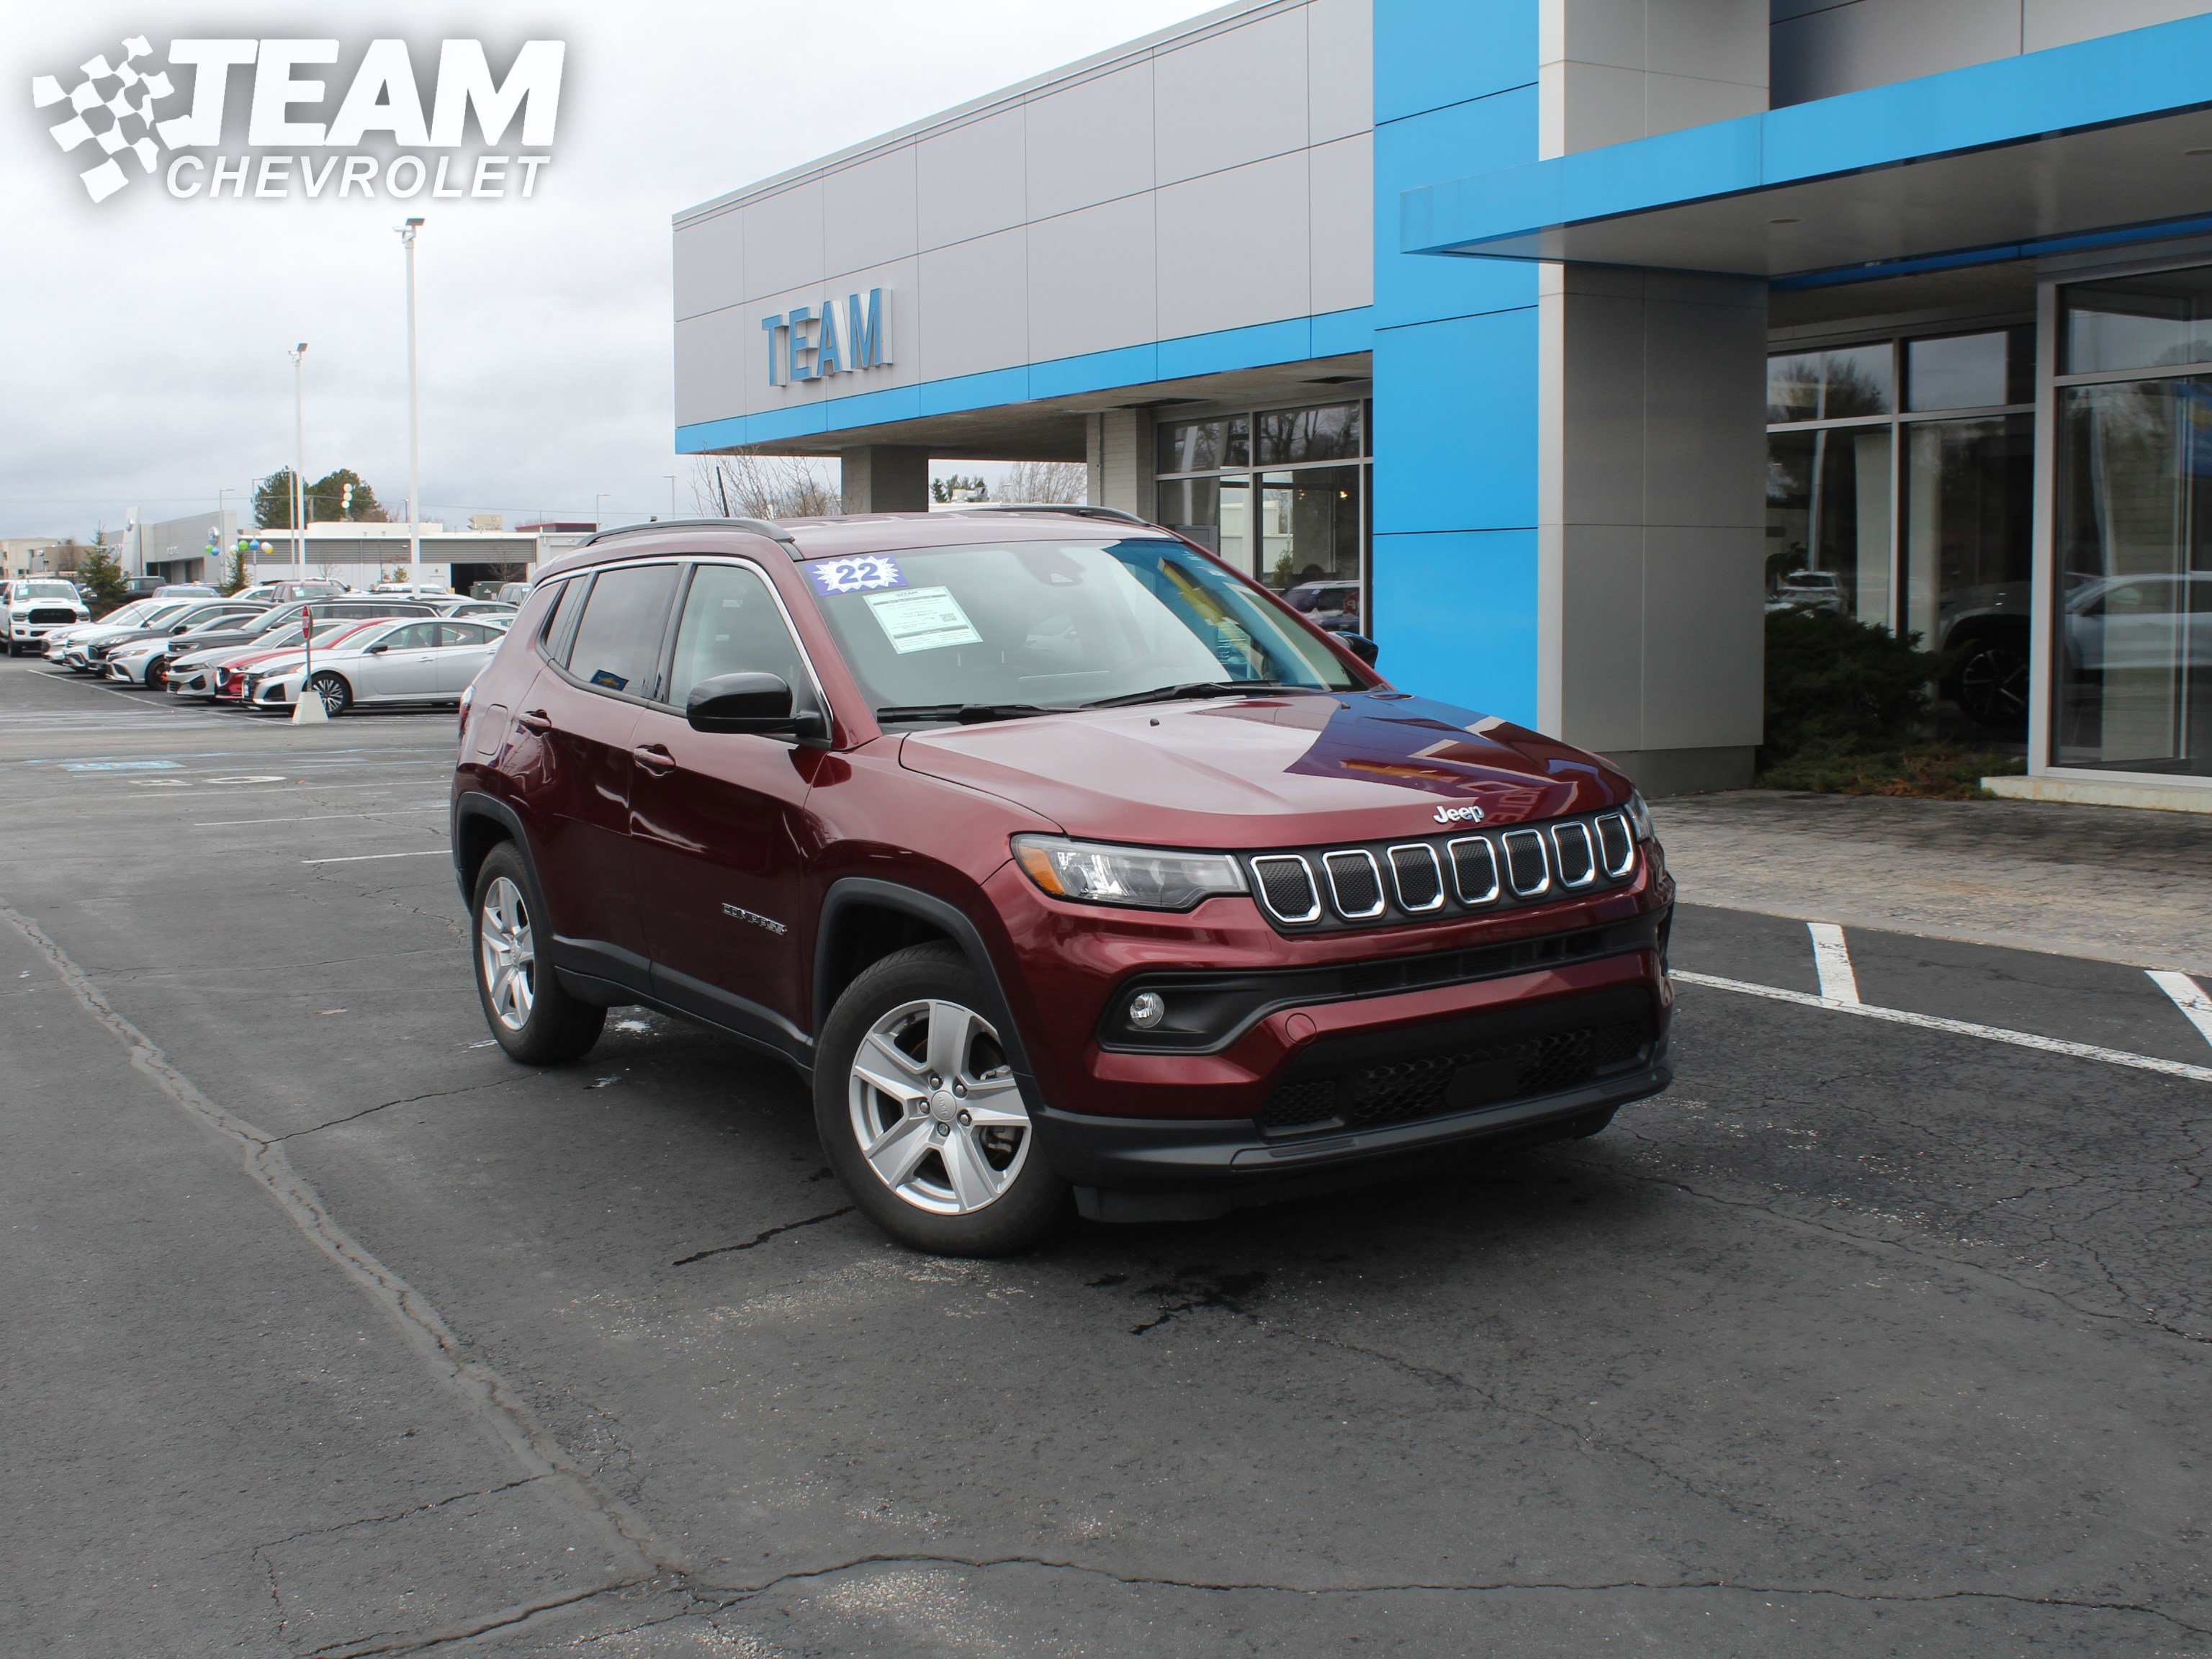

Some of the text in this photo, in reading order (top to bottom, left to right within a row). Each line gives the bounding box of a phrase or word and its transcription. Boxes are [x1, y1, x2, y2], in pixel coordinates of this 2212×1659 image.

[761, 288, 893, 387] TEAM
[836, 562, 881, 584] 22
[1433, 806, 1485, 823] Jeep
